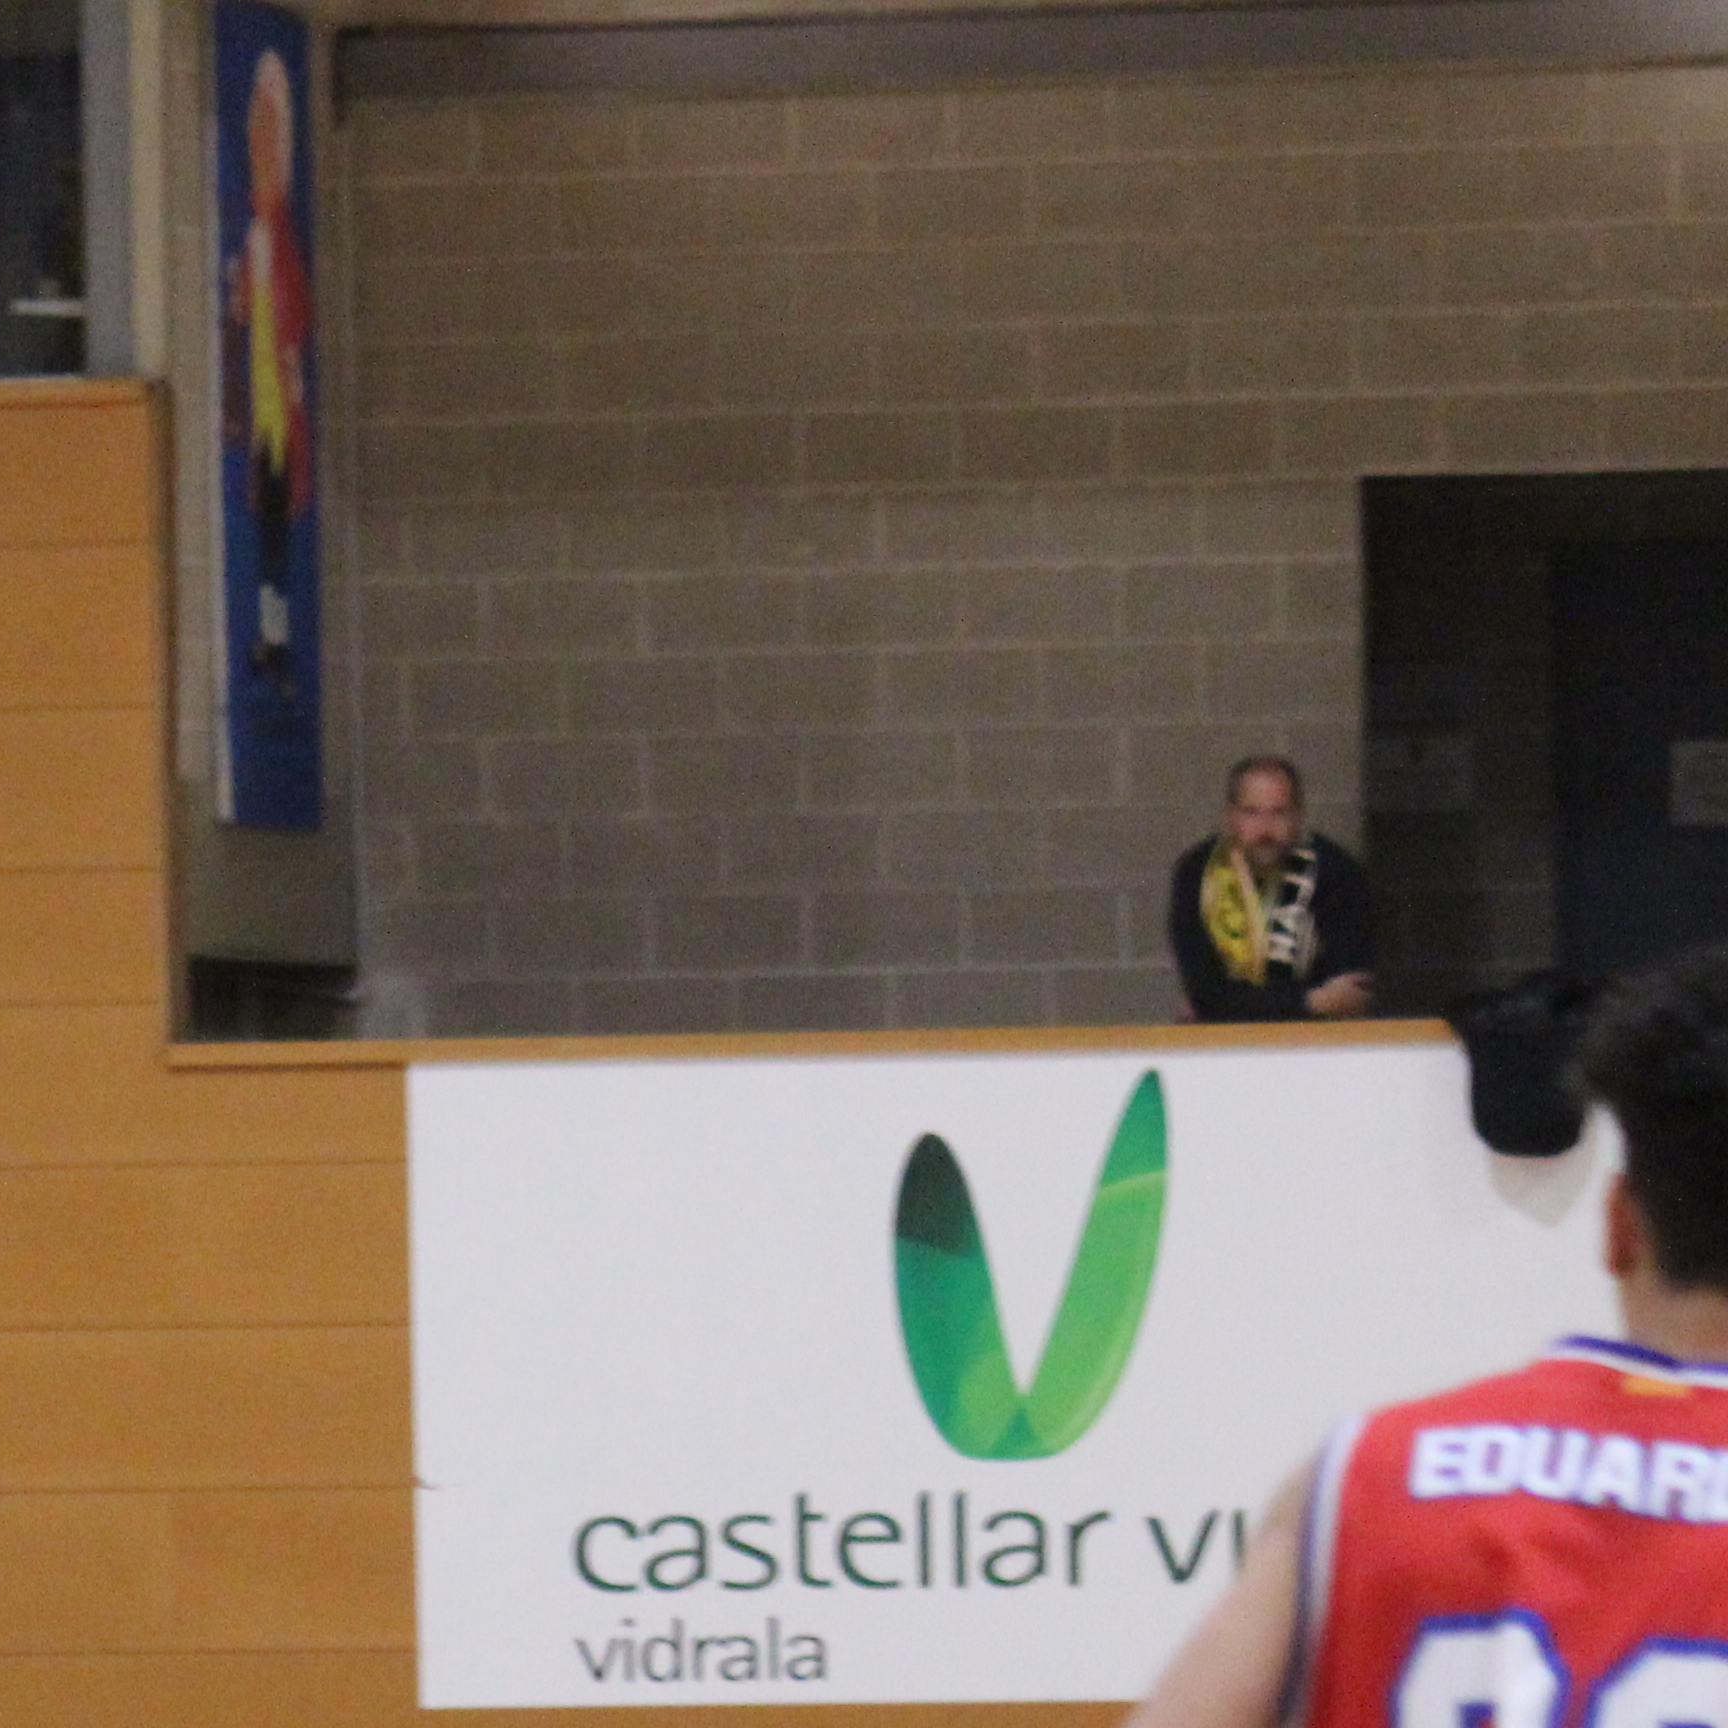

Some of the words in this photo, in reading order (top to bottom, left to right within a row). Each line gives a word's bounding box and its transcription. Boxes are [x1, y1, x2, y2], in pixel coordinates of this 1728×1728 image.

[1406, 1421, 1728, 1529] EDUAR
[572, 1491, 1113, 1594] castellar
[573, 1616, 828, 1683] vidrala
